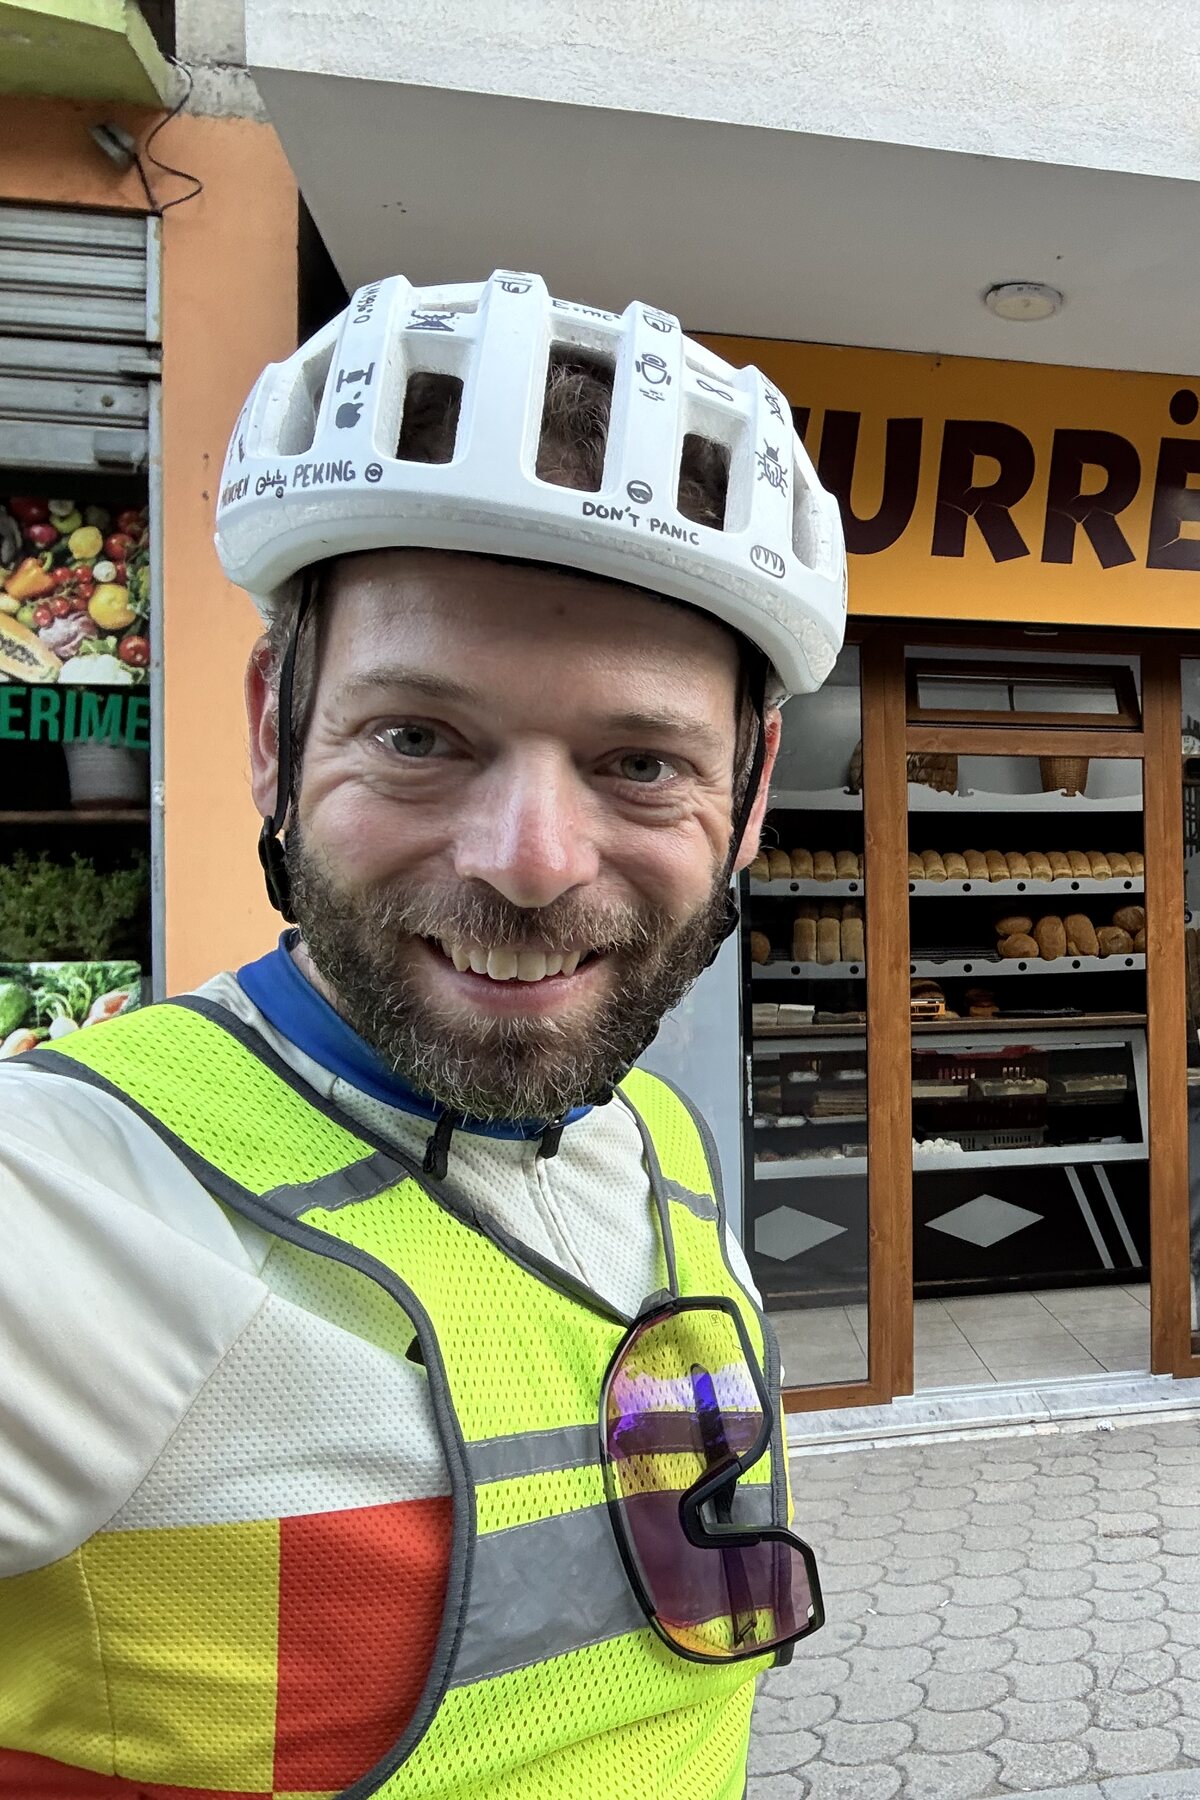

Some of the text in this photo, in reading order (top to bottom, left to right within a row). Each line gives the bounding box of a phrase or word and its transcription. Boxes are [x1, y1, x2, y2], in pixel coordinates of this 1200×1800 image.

[293, 460, 356, 488] PEKING
[582, 501, 700, 546] DON'T PANIC
